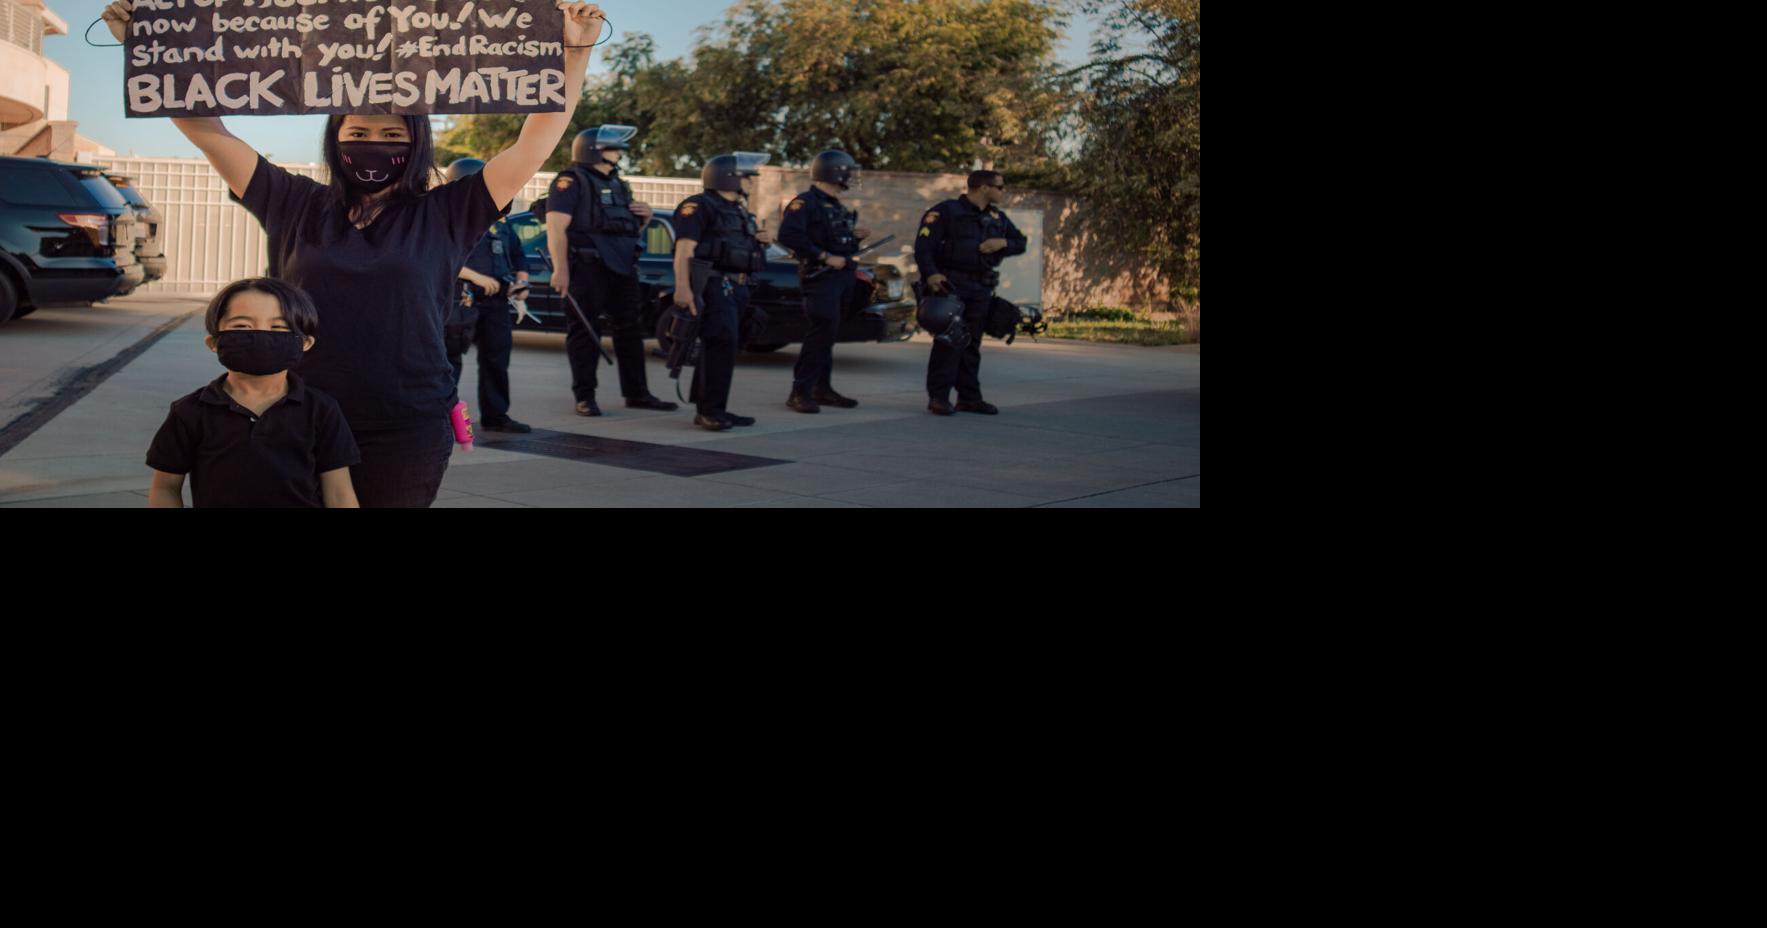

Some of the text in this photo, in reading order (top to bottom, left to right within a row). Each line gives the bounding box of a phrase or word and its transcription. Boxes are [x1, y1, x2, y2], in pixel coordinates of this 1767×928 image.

[133, 17, 197, 36] now
[212, 12, 330, 33] because
[344, 5, 385, 40] of
[478, 7, 534, 29] We
[131, 35, 225, 67] stand
[233, 37, 302, 59] with
[317, 33, 393, 67] you!
[128, 69, 285, 113] BLACK
[424, 67, 565, 105] MATTER
